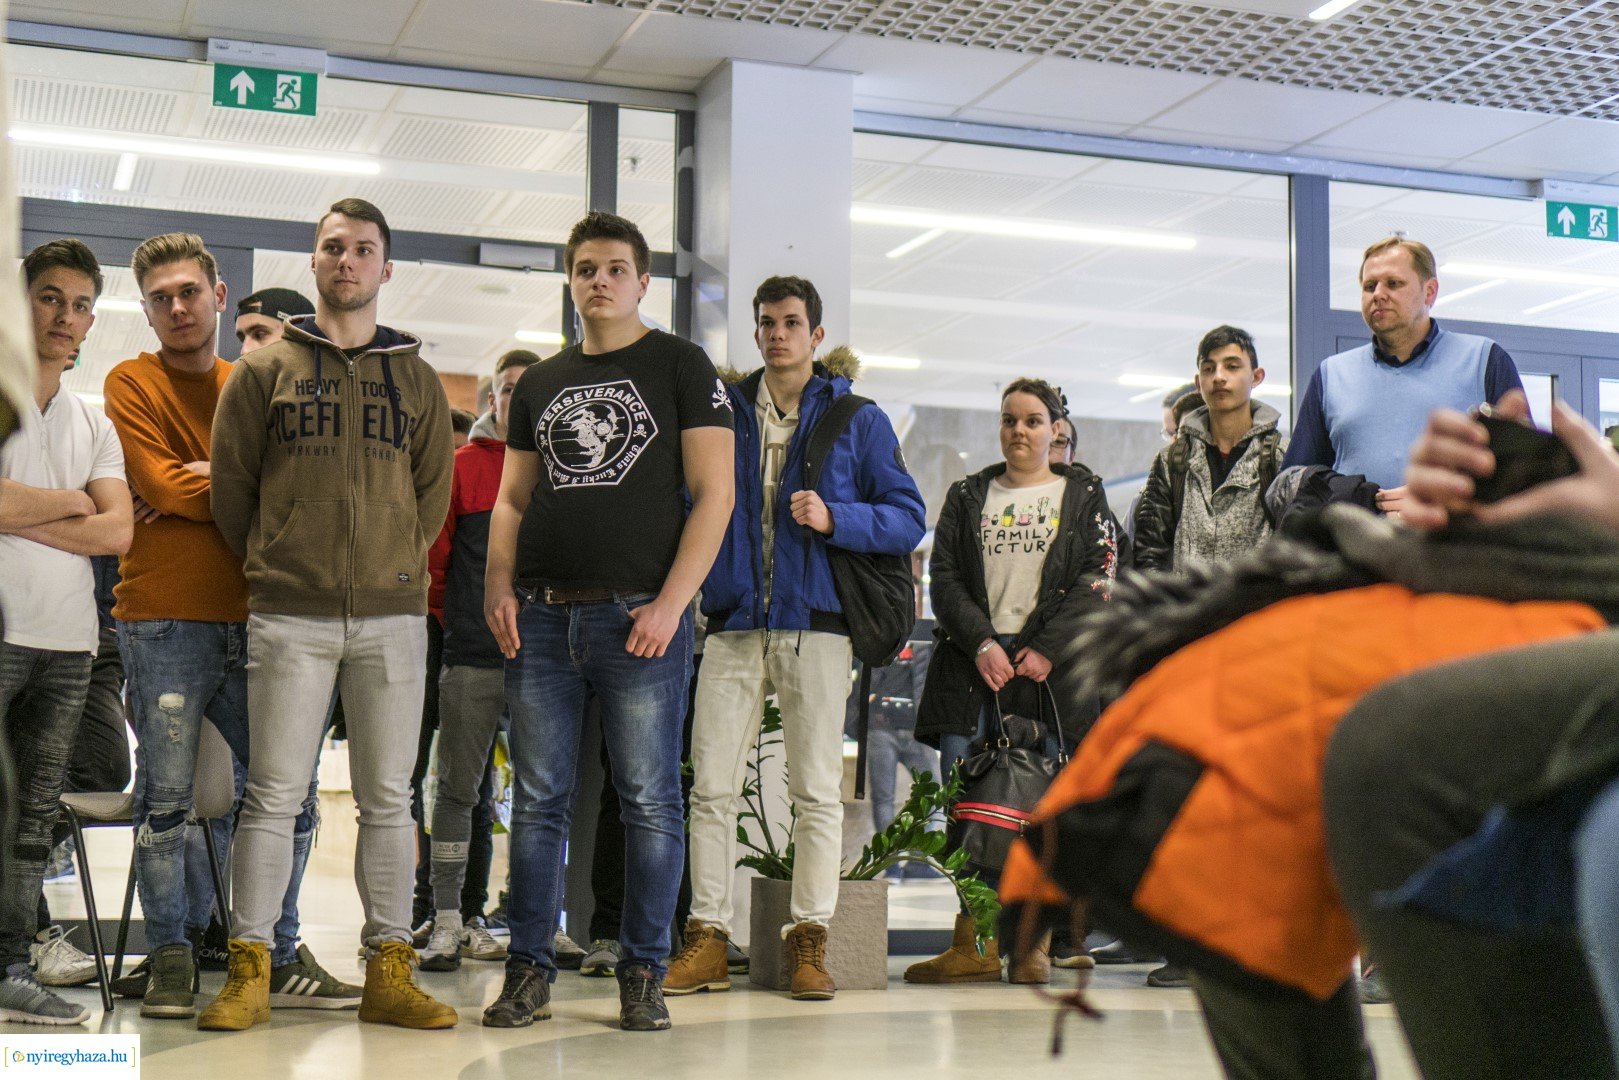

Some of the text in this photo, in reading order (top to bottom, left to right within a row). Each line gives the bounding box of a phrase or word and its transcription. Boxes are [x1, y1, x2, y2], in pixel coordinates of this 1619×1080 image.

[360, 381, 401, 402] TOOS
[538, 387, 647, 431] PERSEVERANCE
[582, 468, 617, 484] Lucky
[983, 528, 1054, 543] FAMILY
